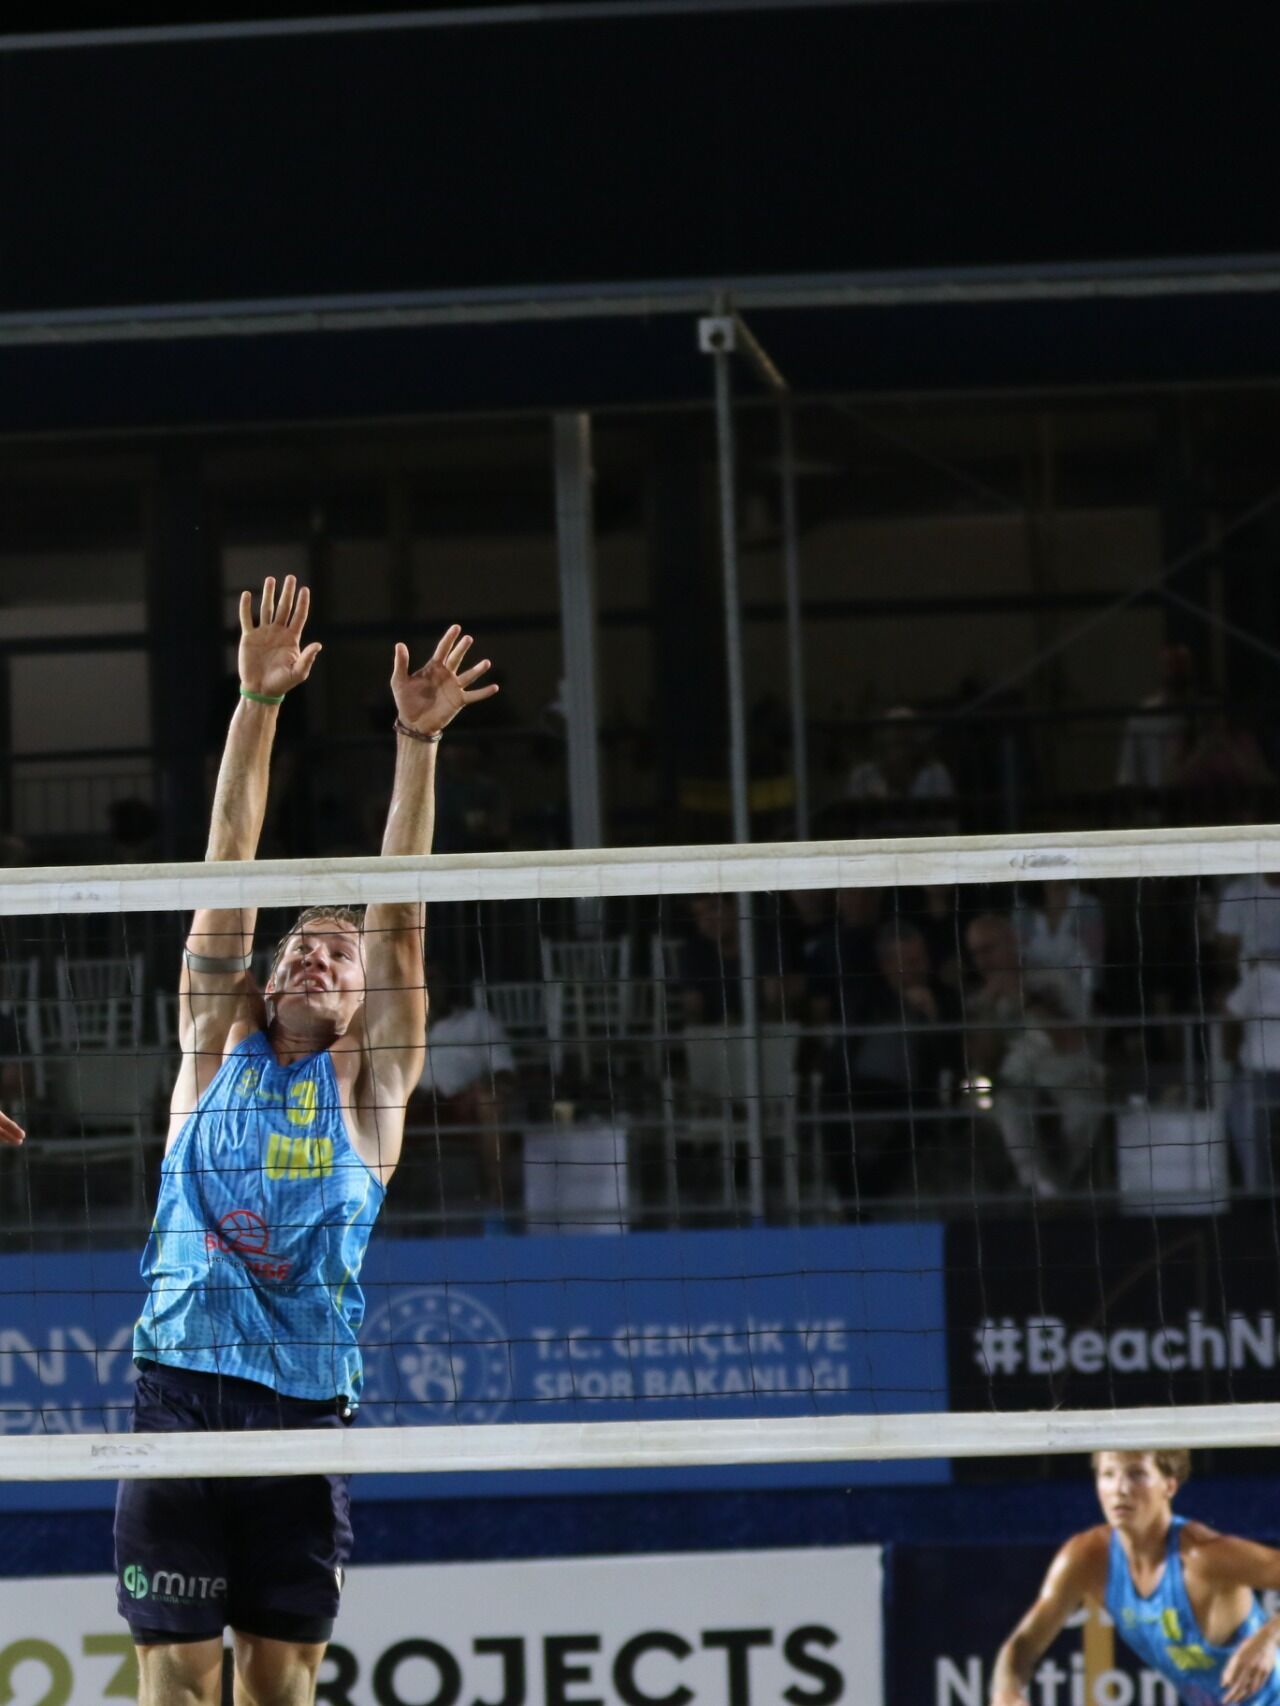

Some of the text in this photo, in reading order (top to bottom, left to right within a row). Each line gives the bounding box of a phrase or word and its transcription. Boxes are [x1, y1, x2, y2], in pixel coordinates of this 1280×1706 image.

[287, 1080, 318, 1126] 3
[266, 1132, 334, 1181] UKR
[532, 1315, 847, 1362] T.C. GENÇLİK VE
[974, 1311, 1280, 1374] #BeachN
[533, 1357, 848, 1403] SPOR BAKANLIĞI
[222, 1624, 845, 1706] ROJECTS
[936, 1652, 1179, 1706] Ntion
